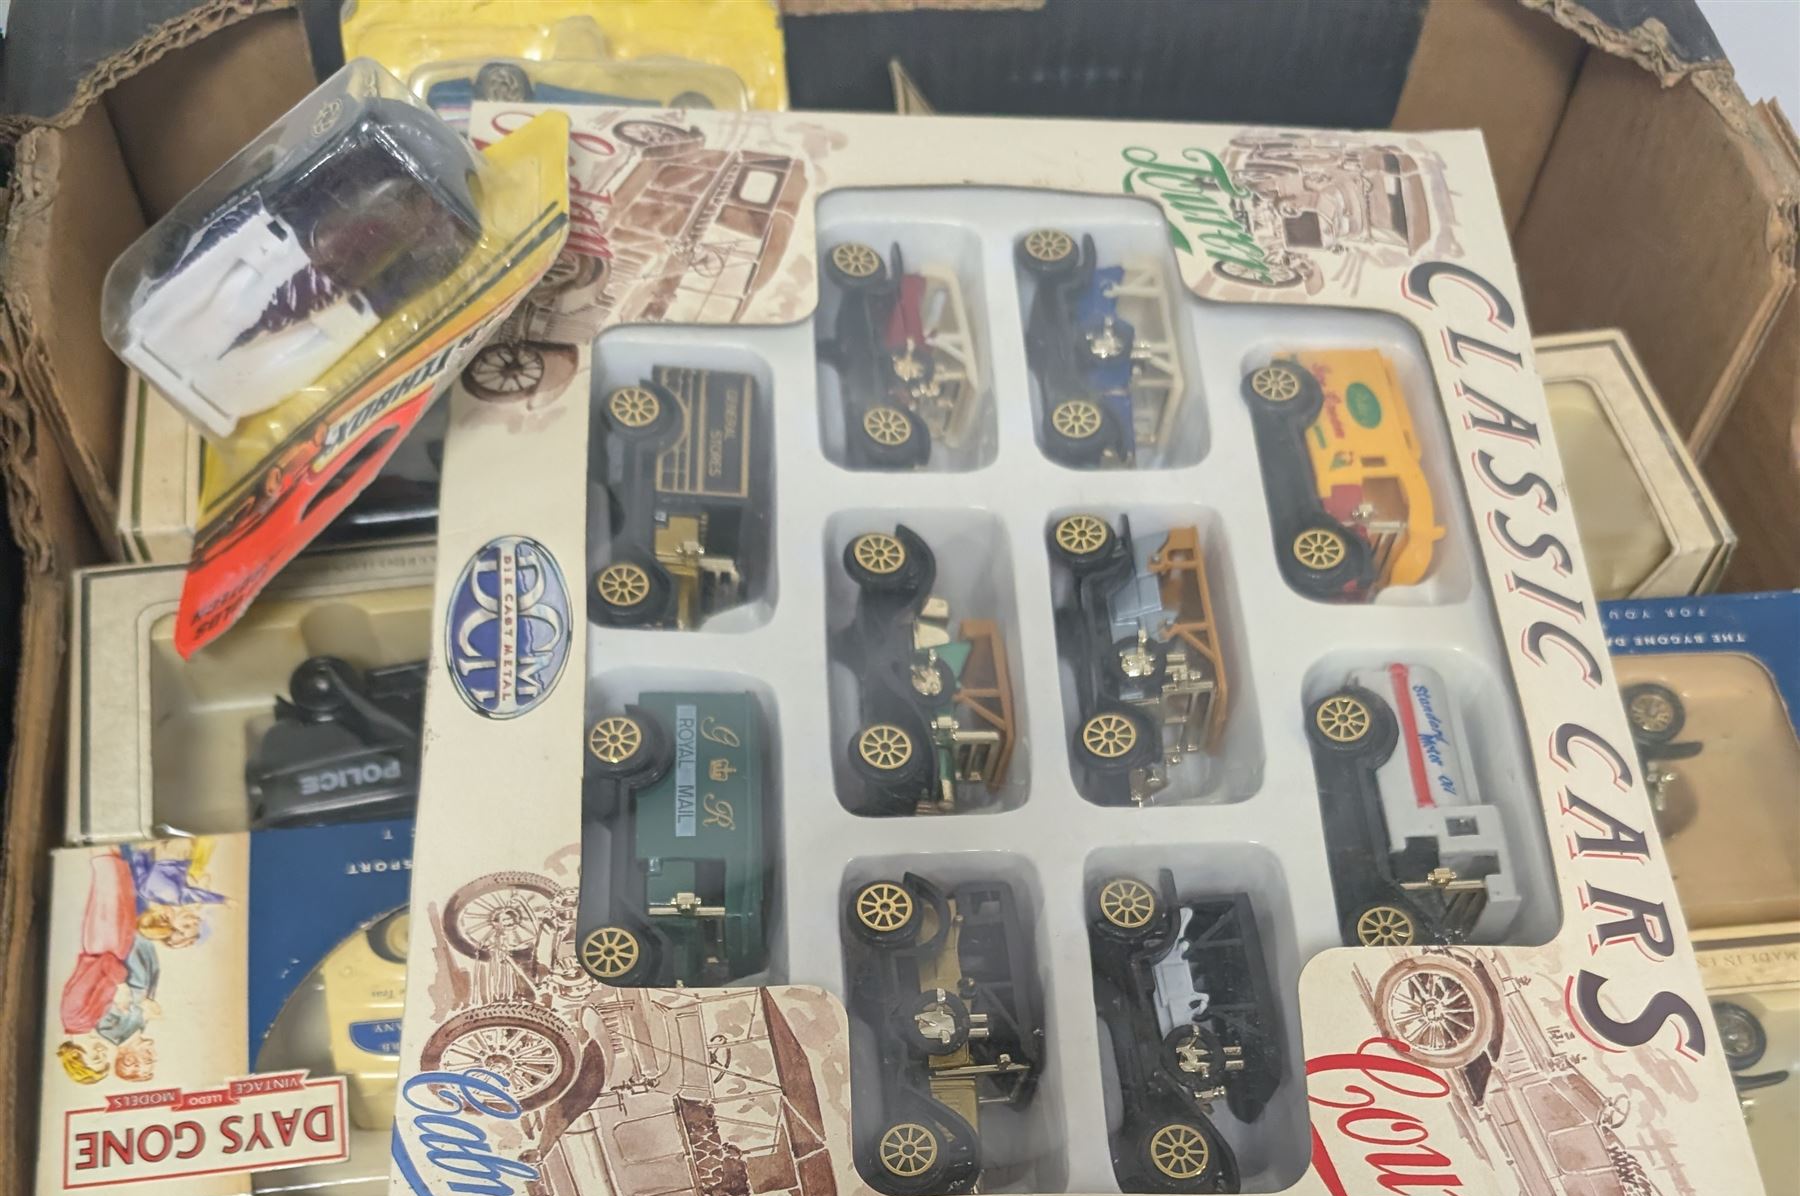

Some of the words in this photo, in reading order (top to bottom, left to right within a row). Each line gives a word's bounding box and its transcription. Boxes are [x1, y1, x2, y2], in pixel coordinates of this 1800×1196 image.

[1121, 147, 1275, 284] Tourer
[708, 430, 722, 477] STORES
[503, 555, 513, 586] DIE
[503, 593, 513, 639] CAST
[1608, 609, 1650, 620] YOU
[1634, 634, 1704, 646] BYGONE
[1711, 633, 1746, 644] THE
[502, 644, 514, 702] METAL
[1401, 260, 1602, 688] CLASSIC
[1549, 722, 1707, 1062] CARS
[678, 717, 695, 769] ROYAL
[299, 758, 402, 795] POLICE
[1417, 733, 1443, 767] Motor
[1438, 775, 1457, 796] Oil
[678, 785, 695, 824] MAIL
[1724, 955, 1742, 967] IN
[1751, 950, 1798, 964] MADE
[114, 1092, 176, 1109] MODELS
[188, 1094, 223, 1107] LLEDO
[234, 1075, 299, 1093] VINTAGE
[75, 1121, 207, 1170] GONE
[221, 1107, 335, 1154] DAYS
